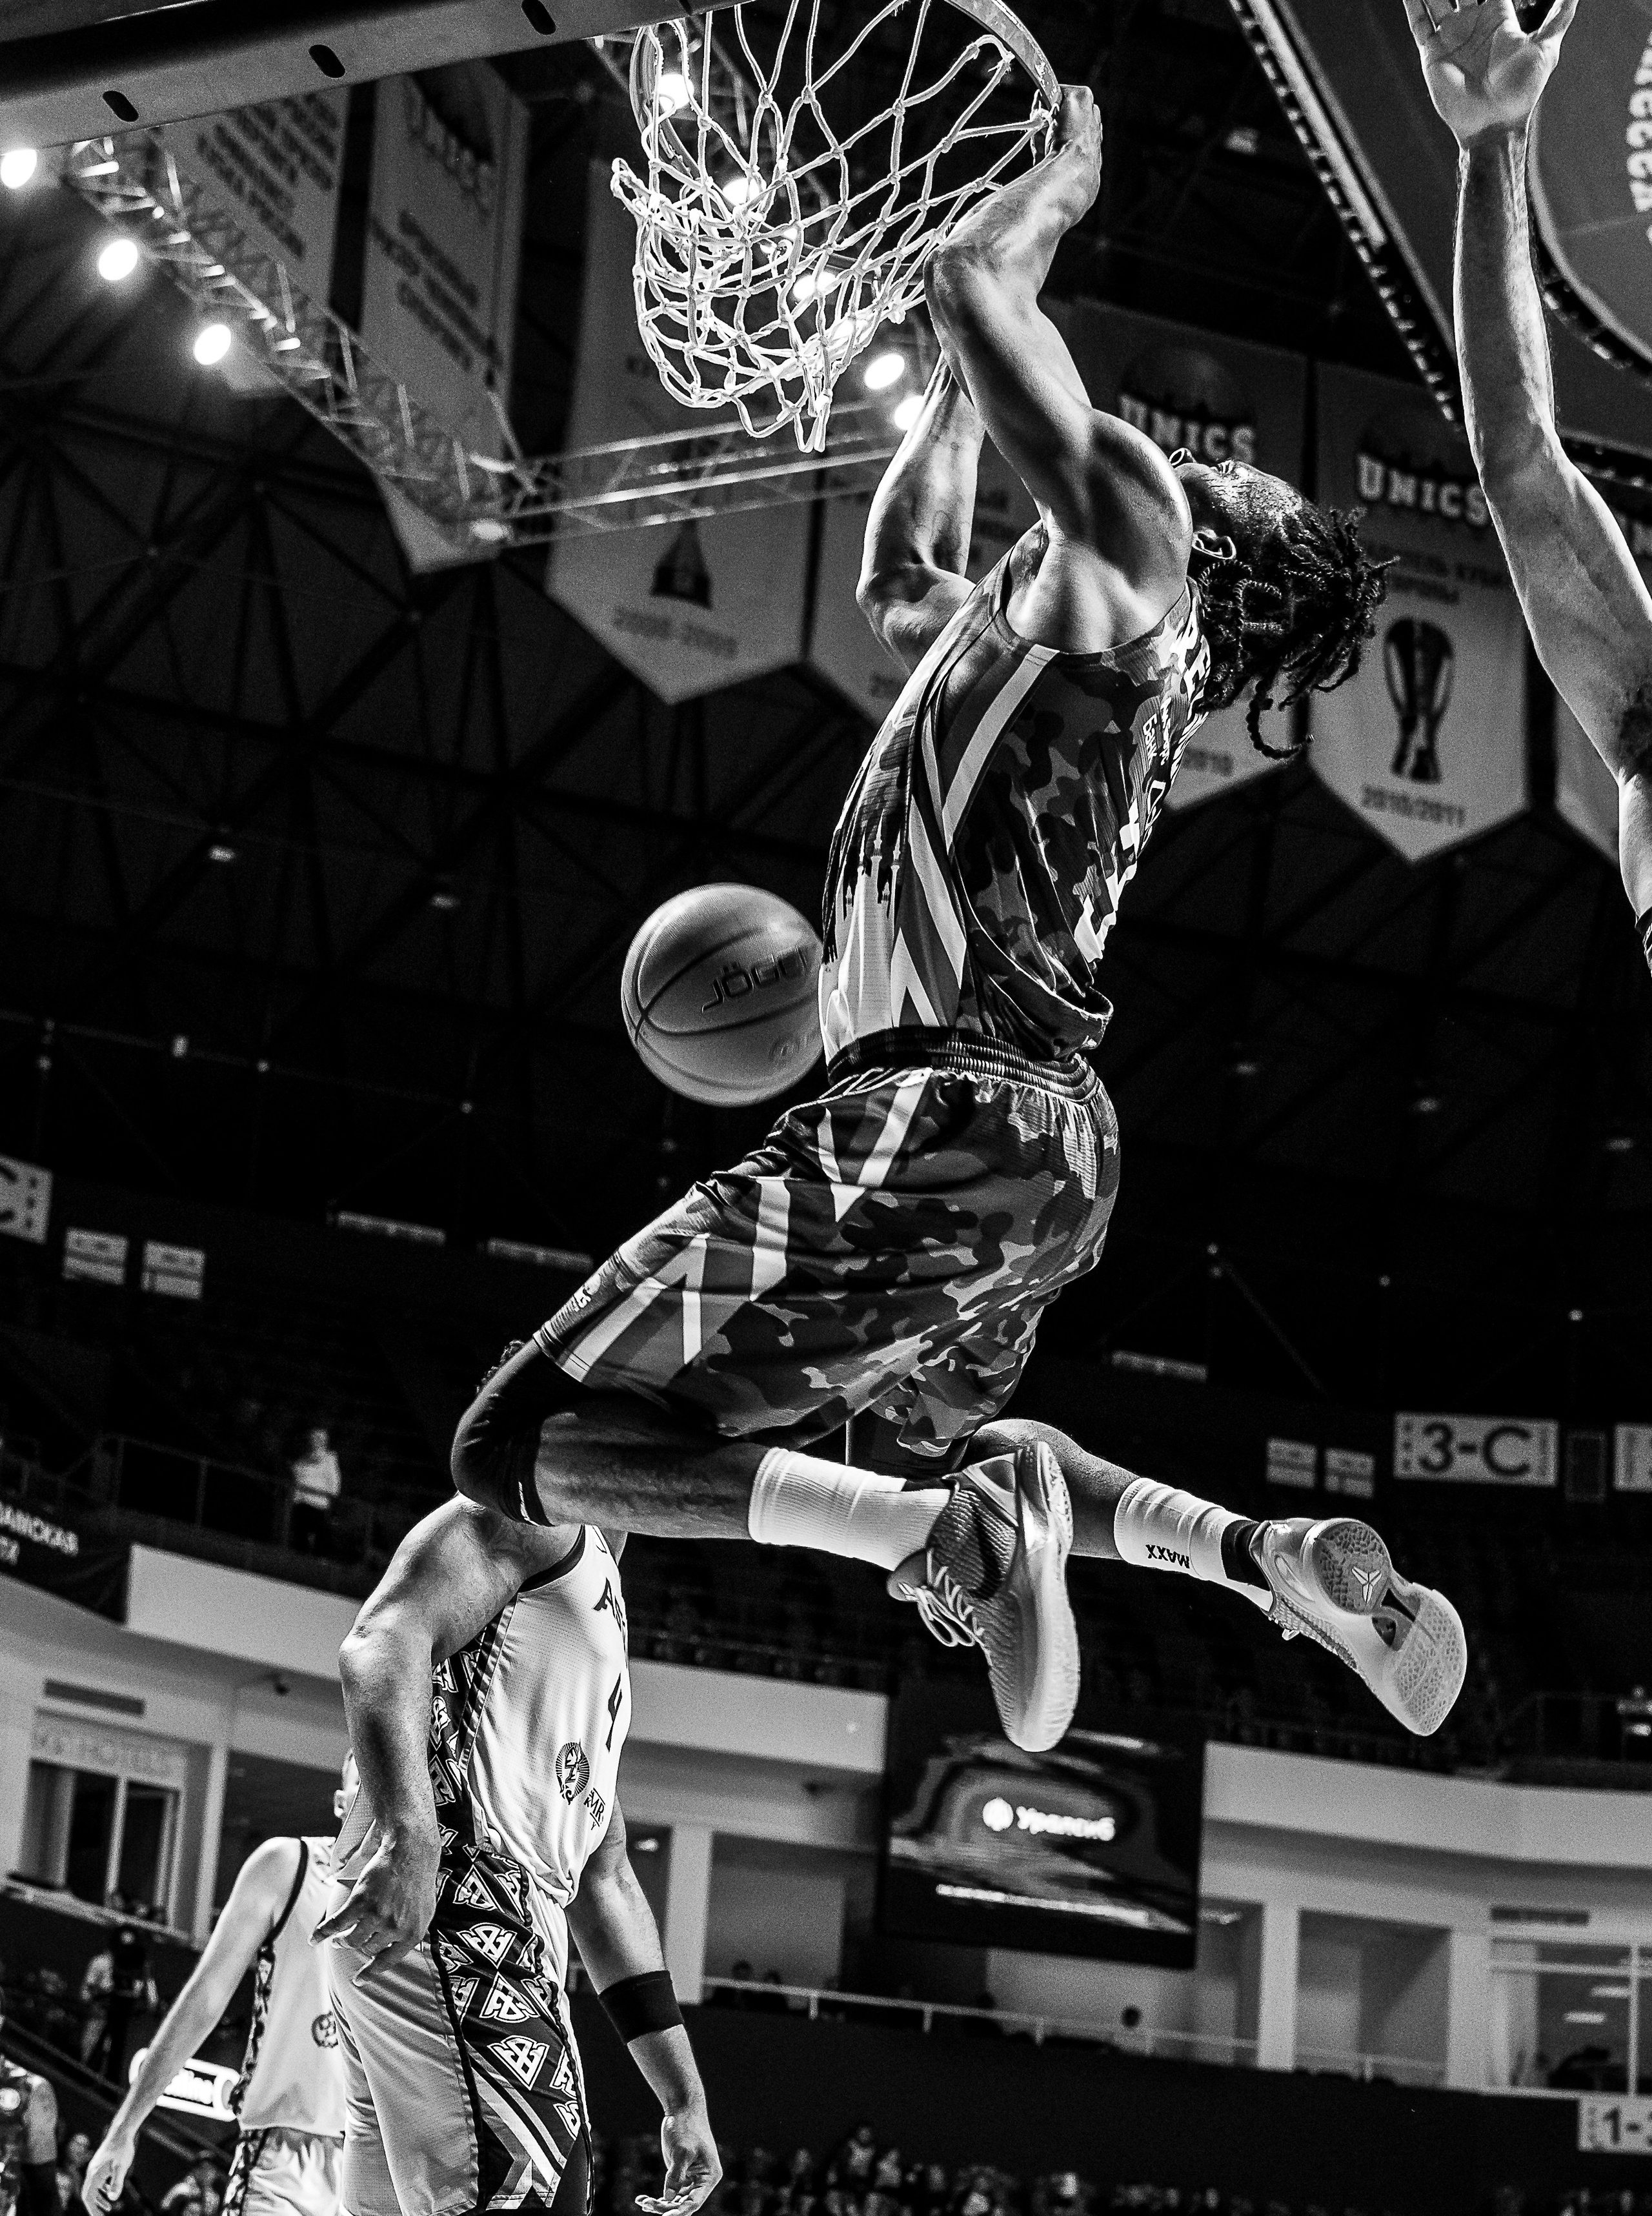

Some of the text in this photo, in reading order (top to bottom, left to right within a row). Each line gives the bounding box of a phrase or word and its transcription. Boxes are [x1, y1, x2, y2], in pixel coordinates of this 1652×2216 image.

[1356, 451, 1488, 527] UNICS
[1142, 712, 1158, 766] Банк
[1420, 1422, 1532, 1478] 3-C
[1145, 1544, 1190, 1569] MAXX
[1603, 2106, 1652, 2146] 1-
